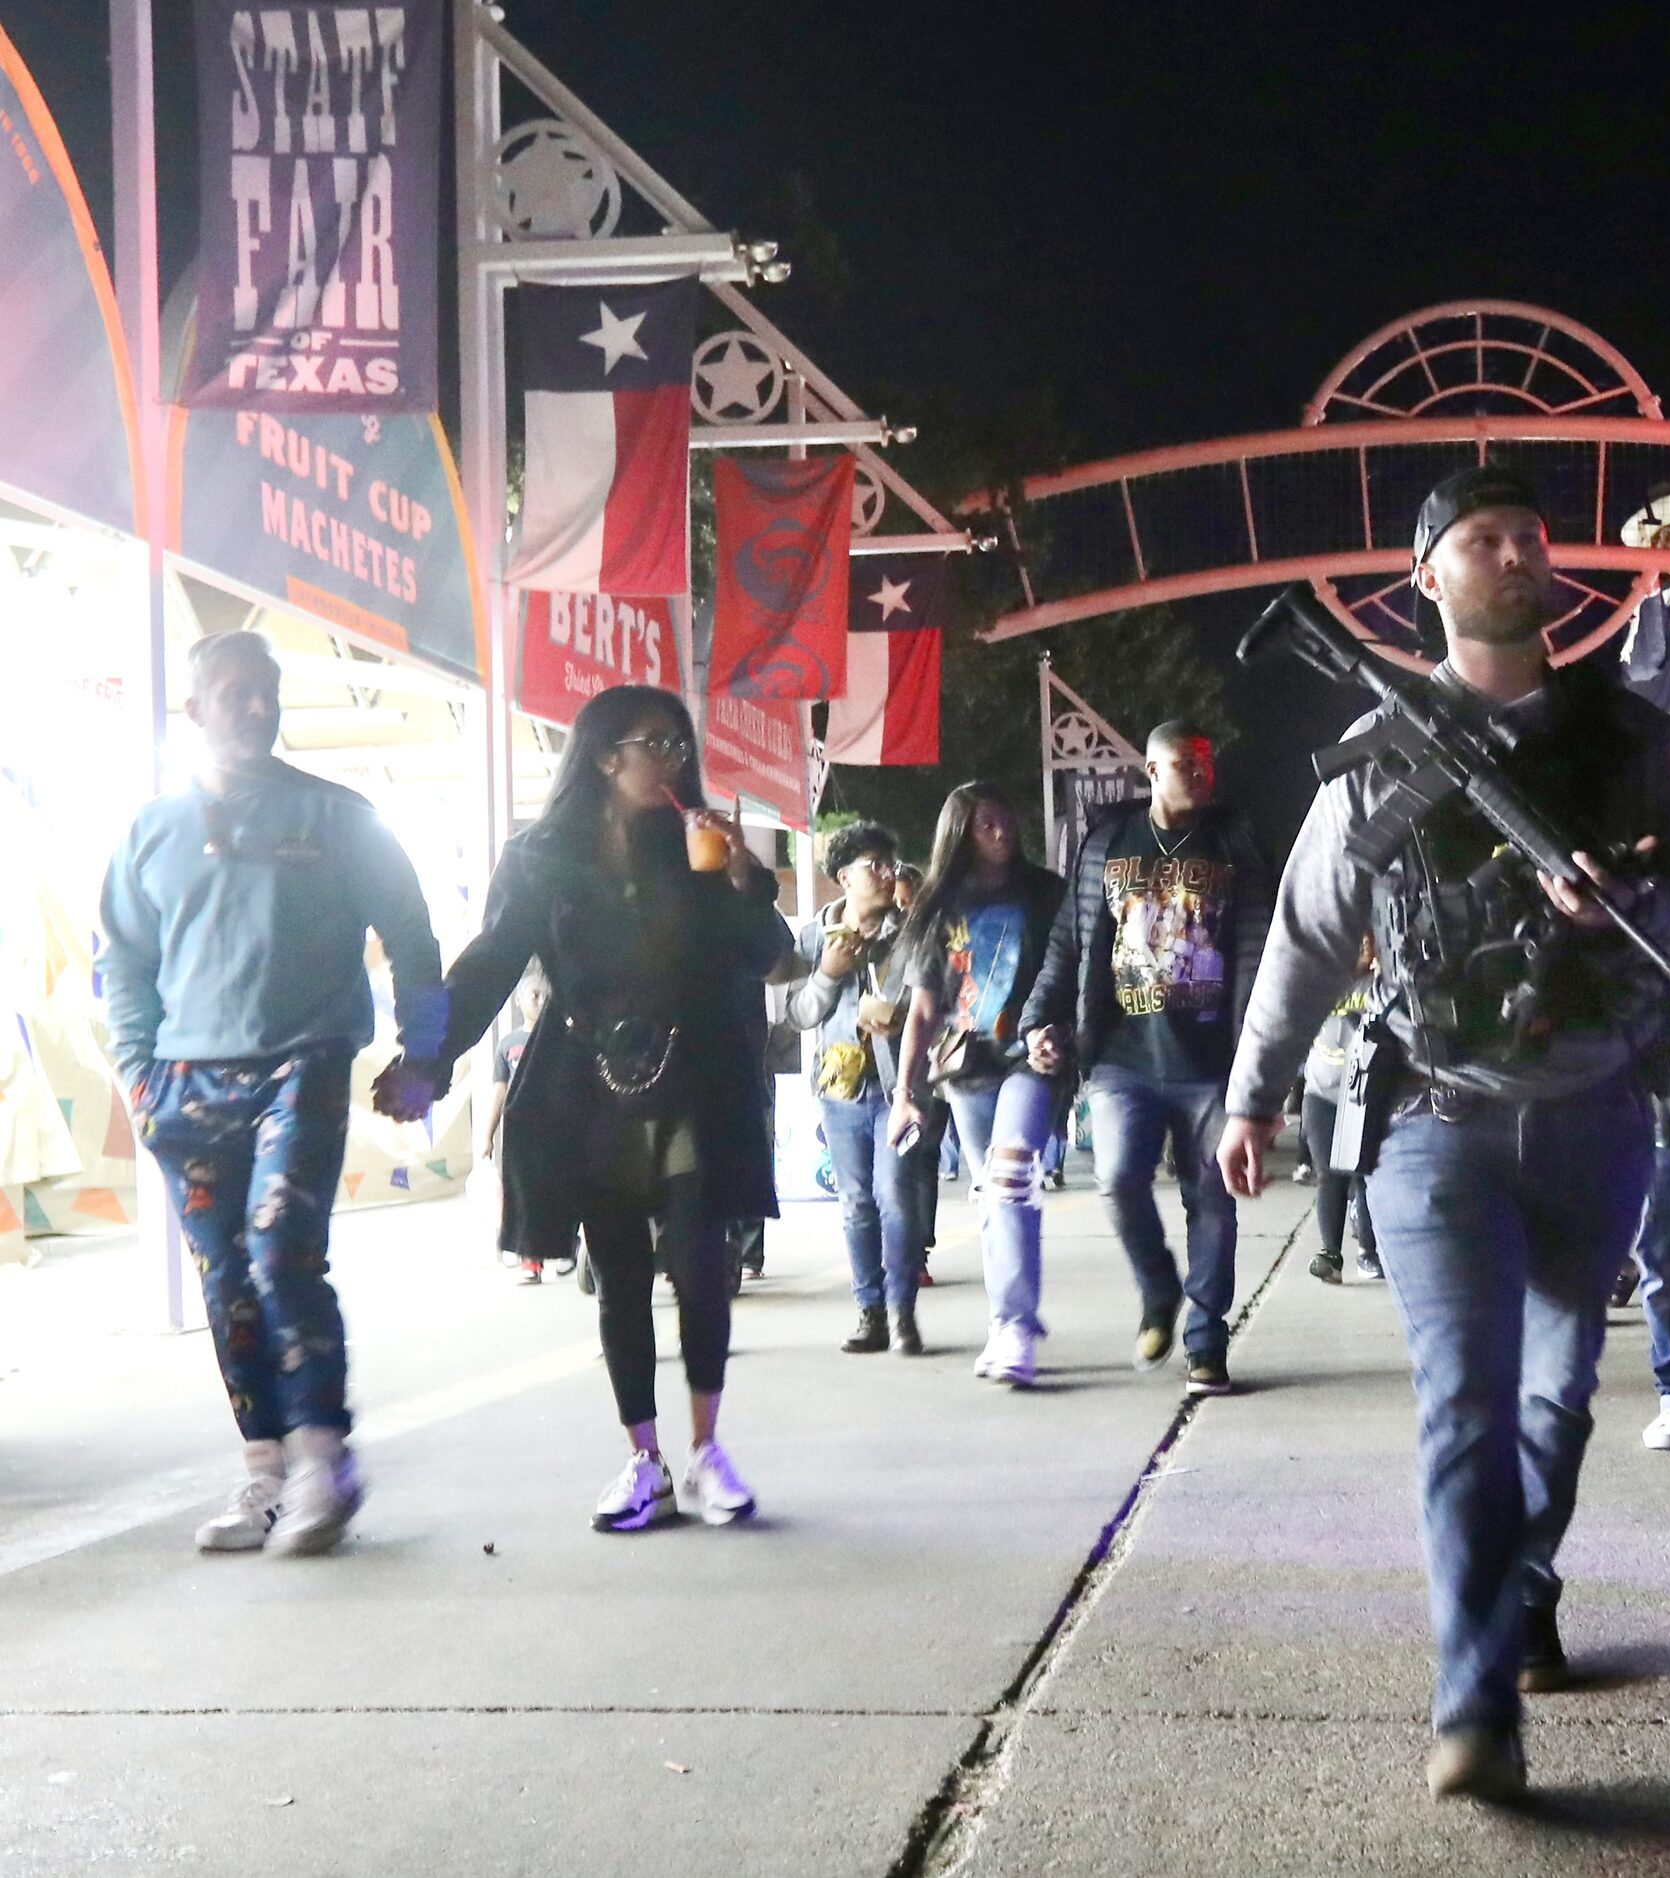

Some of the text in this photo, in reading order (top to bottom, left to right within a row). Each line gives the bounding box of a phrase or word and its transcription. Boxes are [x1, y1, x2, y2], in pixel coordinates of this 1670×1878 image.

[231, 153, 399, 331] FAIR
[226, 353, 400, 395] TEXAS
[290, 331, 332, 351] OF
[236, 411, 432, 541] FRUIT CUP
[261, 480, 418, 604] MACHETES
[550, 592, 661, 688] BERT'S
